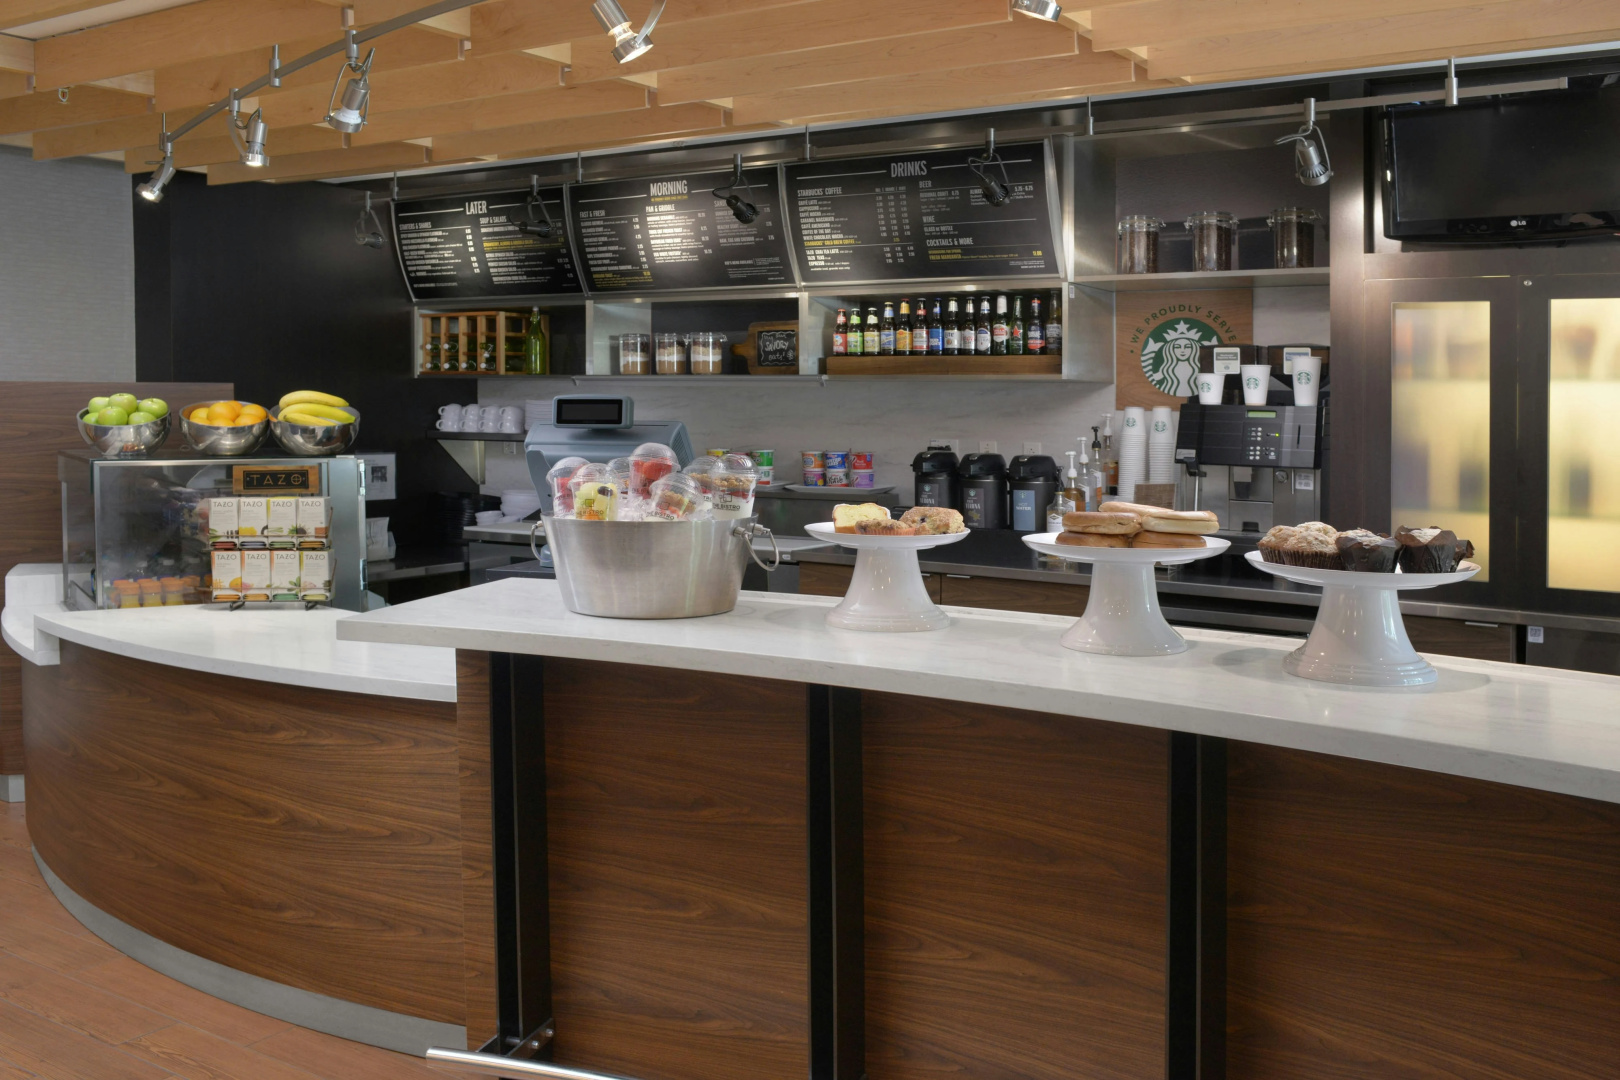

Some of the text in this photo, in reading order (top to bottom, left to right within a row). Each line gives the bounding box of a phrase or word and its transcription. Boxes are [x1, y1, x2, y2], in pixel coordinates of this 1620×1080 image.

[890, 160, 927, 178] DRINKS
[650, 180, 688, 196] MORNING
[919, 180, 932, 188] BEER
[825, 187, 842, 195] COFFEE
[466, 201, 487, 215] LATER
[926, 238, 952, 247] COCKTAILS
[959, 237, 973, 245] MORE
[1130, 304, 1237, 344] WE PROUDLY SERVE
[765, 340, 789, 351] SAVORY
[250, 474, 302, 485] TAZO
[654, 511, 674, 520] BISTRO
